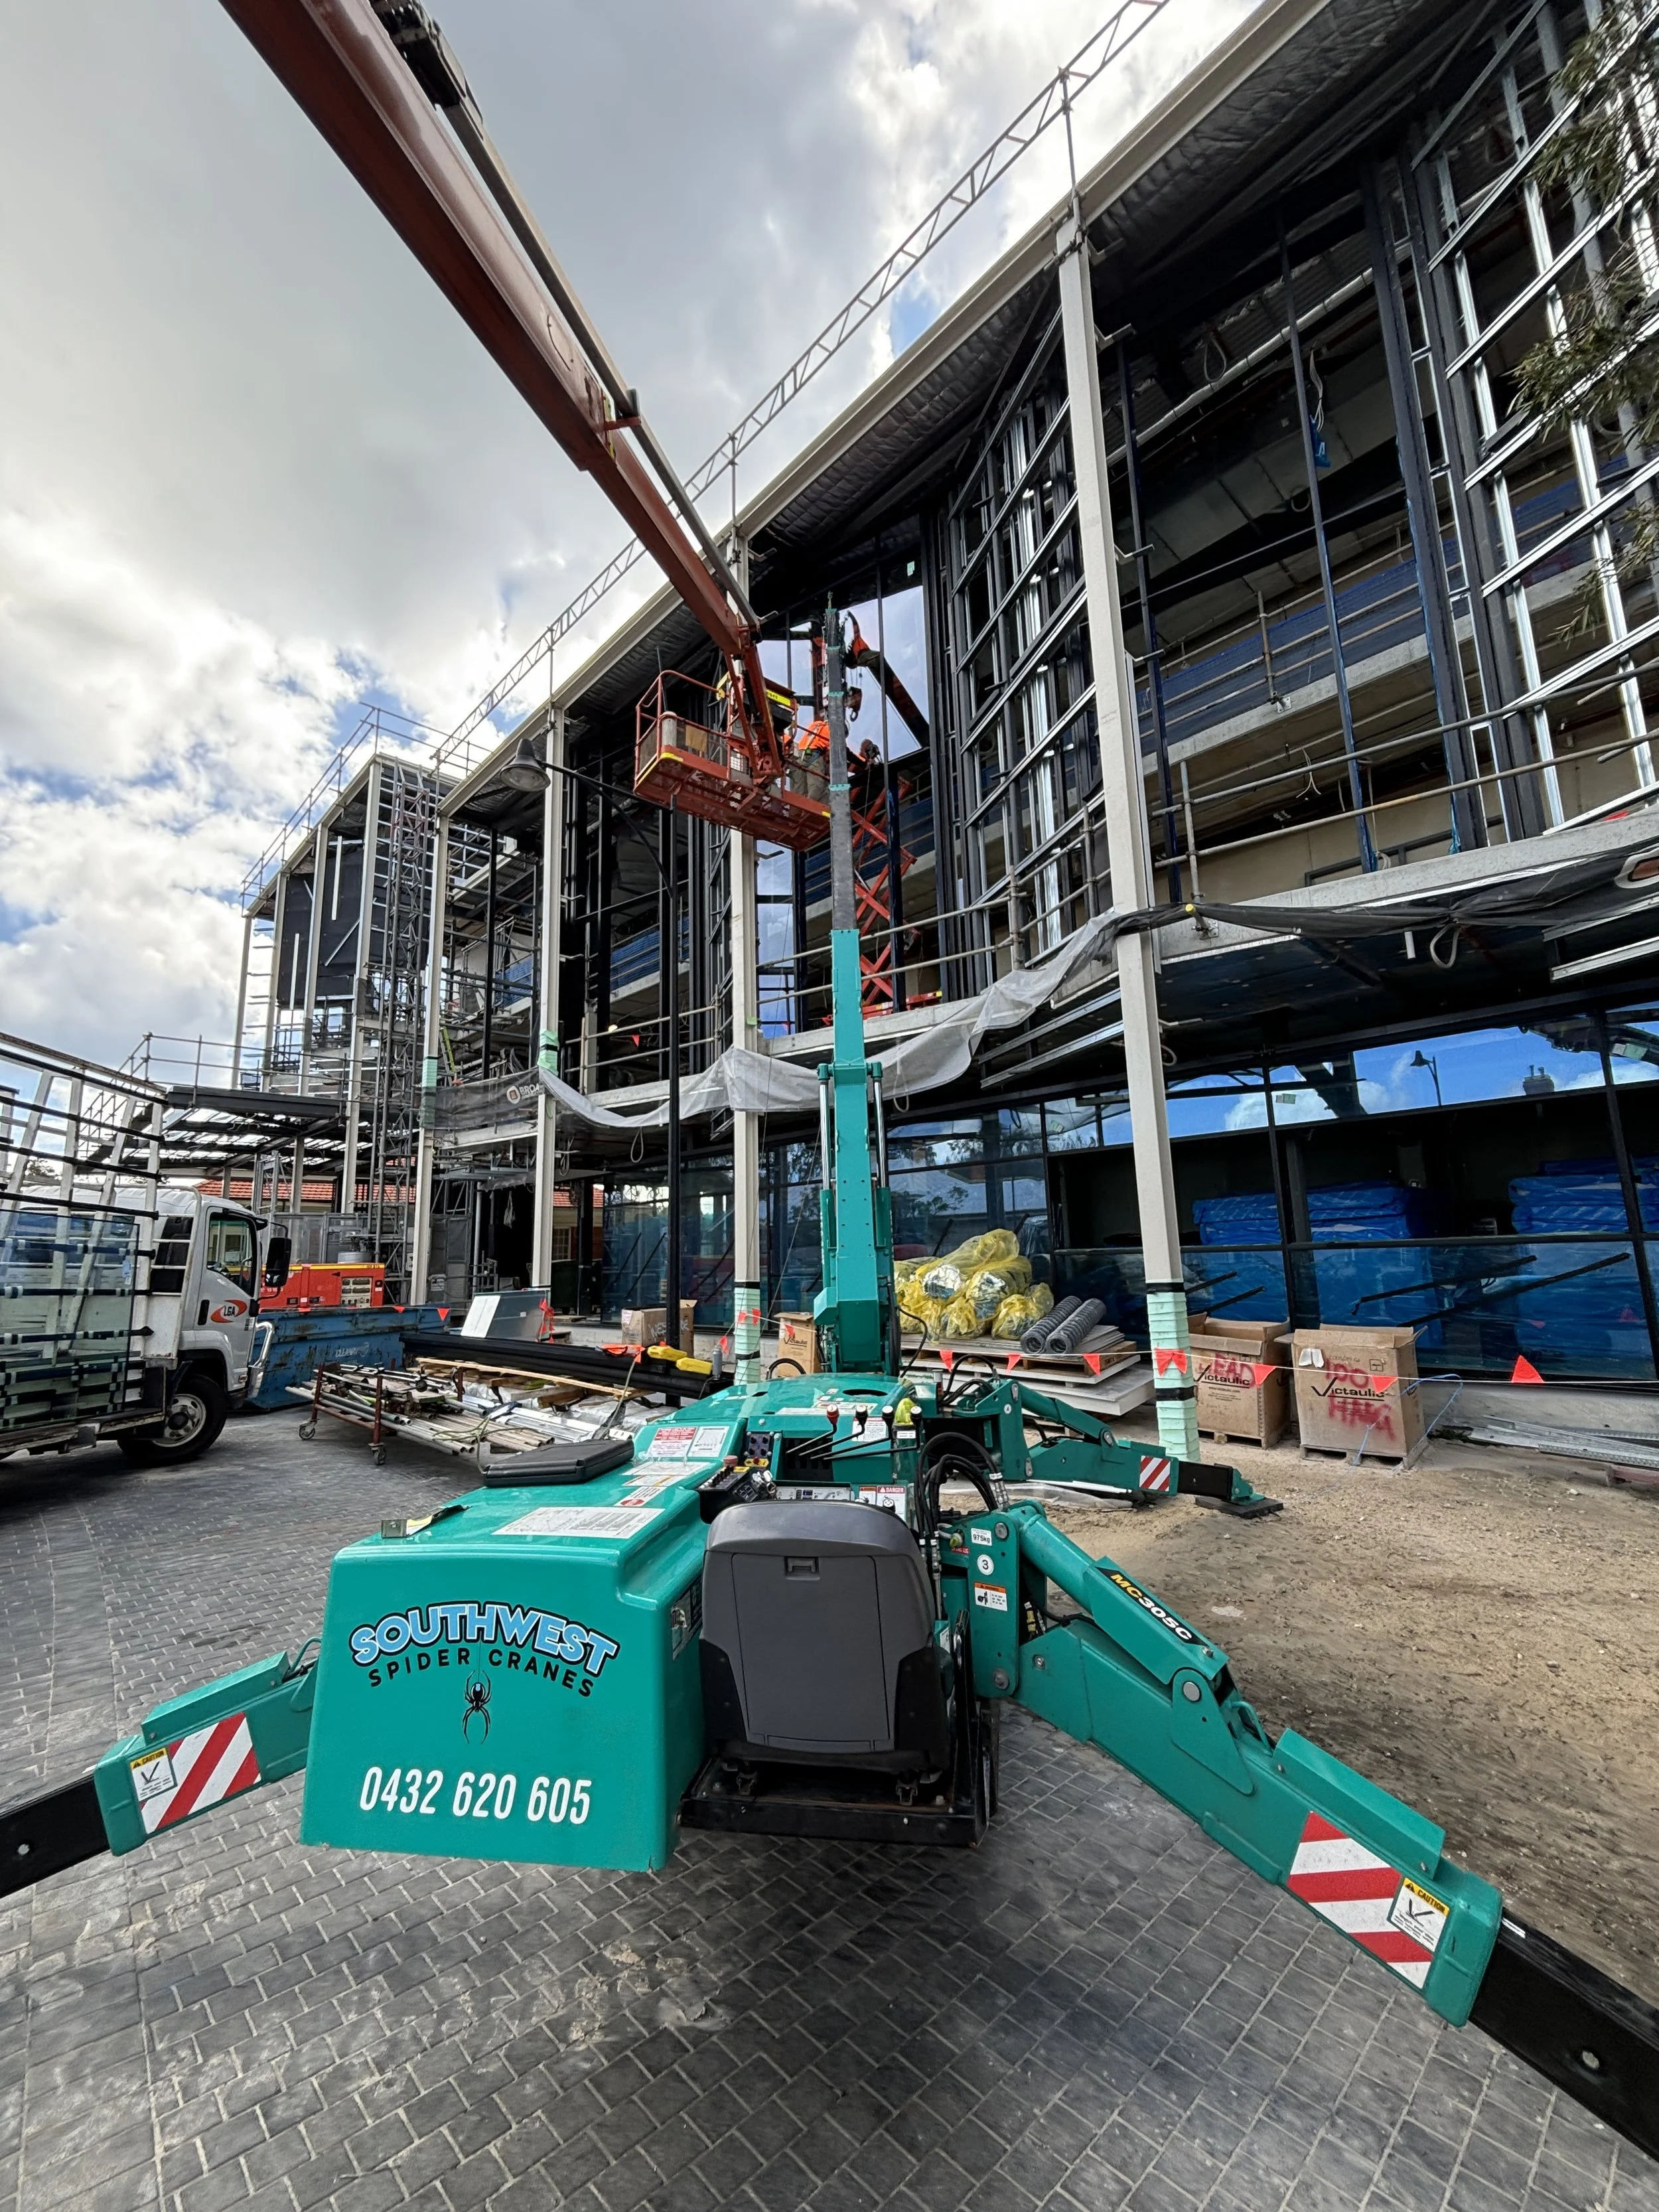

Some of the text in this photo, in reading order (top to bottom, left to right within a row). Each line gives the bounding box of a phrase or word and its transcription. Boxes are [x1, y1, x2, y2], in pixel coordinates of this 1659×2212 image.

[224, 1306, 236, 1316] LGA
[973, 1534, 991, 1544] 975kg
[982, 1560, 989, 1570] 3
[1110, 1574, 1192, 1641] MC305C
[349, 1601, 620, 1676] SOUTHWEST
[368, 1648, 595, 1698] SPIDER CRANES
[359, 1766, 592, 1825] 0432 620 605
[1417, 1889, 1446, 1913] CAUTION
